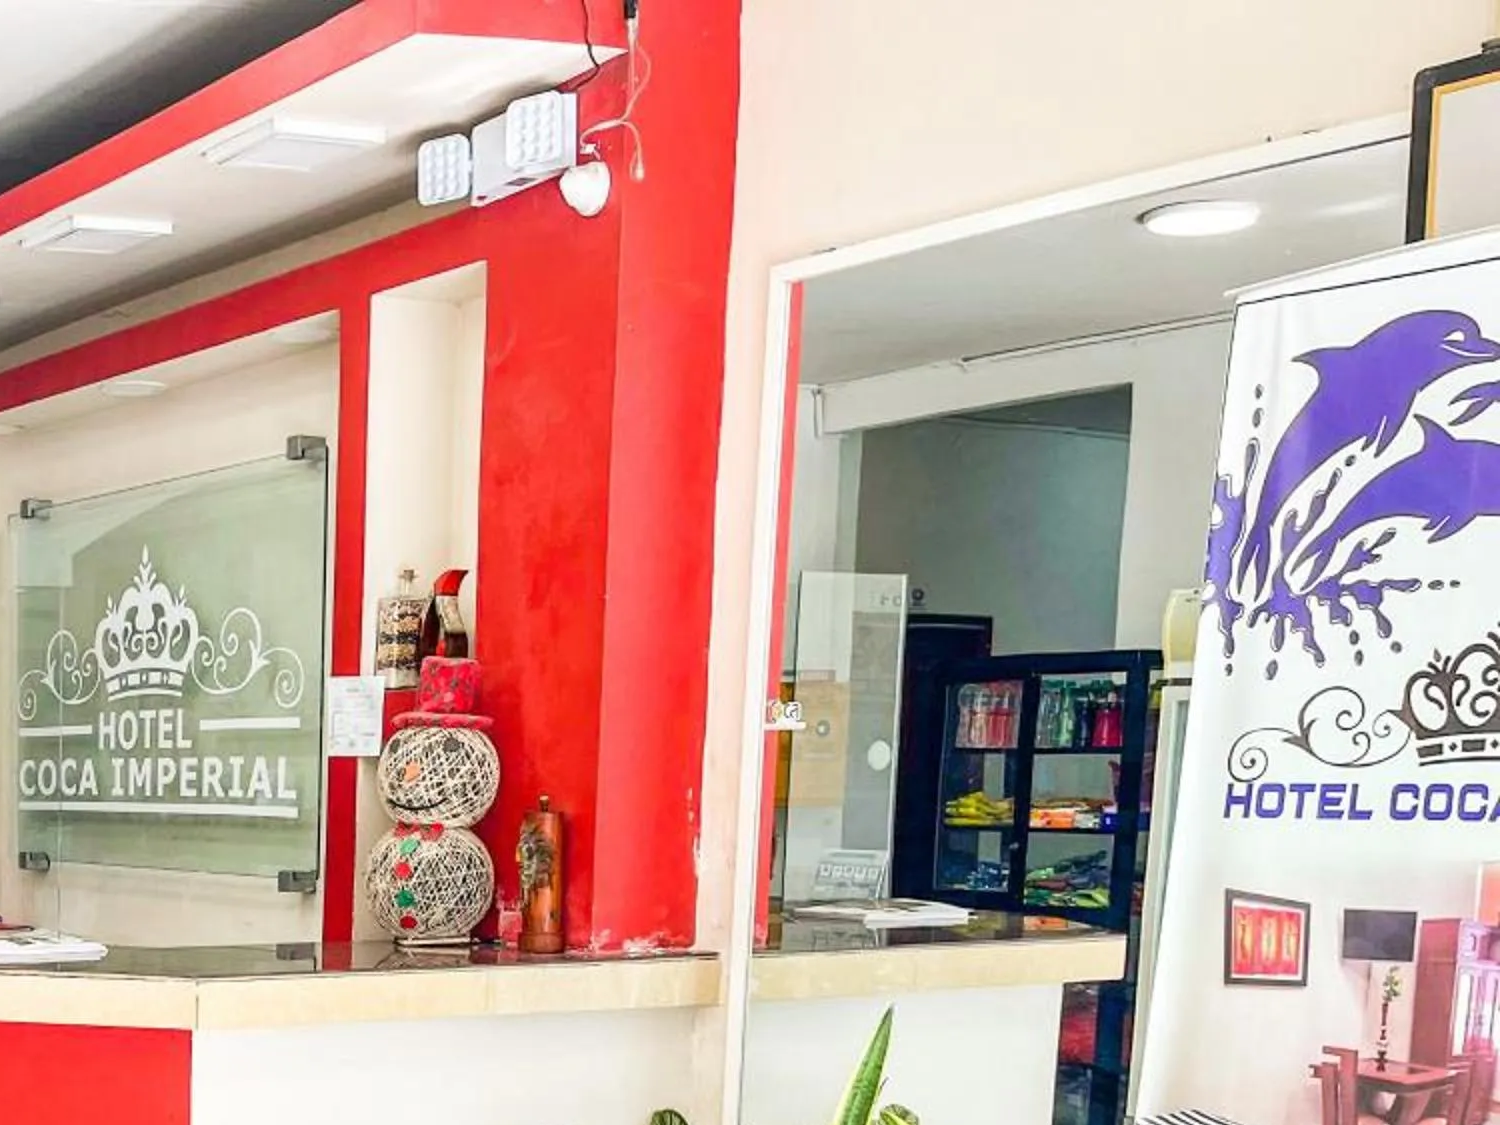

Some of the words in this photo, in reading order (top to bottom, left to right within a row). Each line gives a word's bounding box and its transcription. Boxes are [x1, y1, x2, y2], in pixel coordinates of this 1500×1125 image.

[98, 708, 192, 750] HOTEL
[19, 759, 99, 797] COCA
[111, 756, 297, 800] IMPERIAL
[1222, 782, 1374, 821] HOTEL
